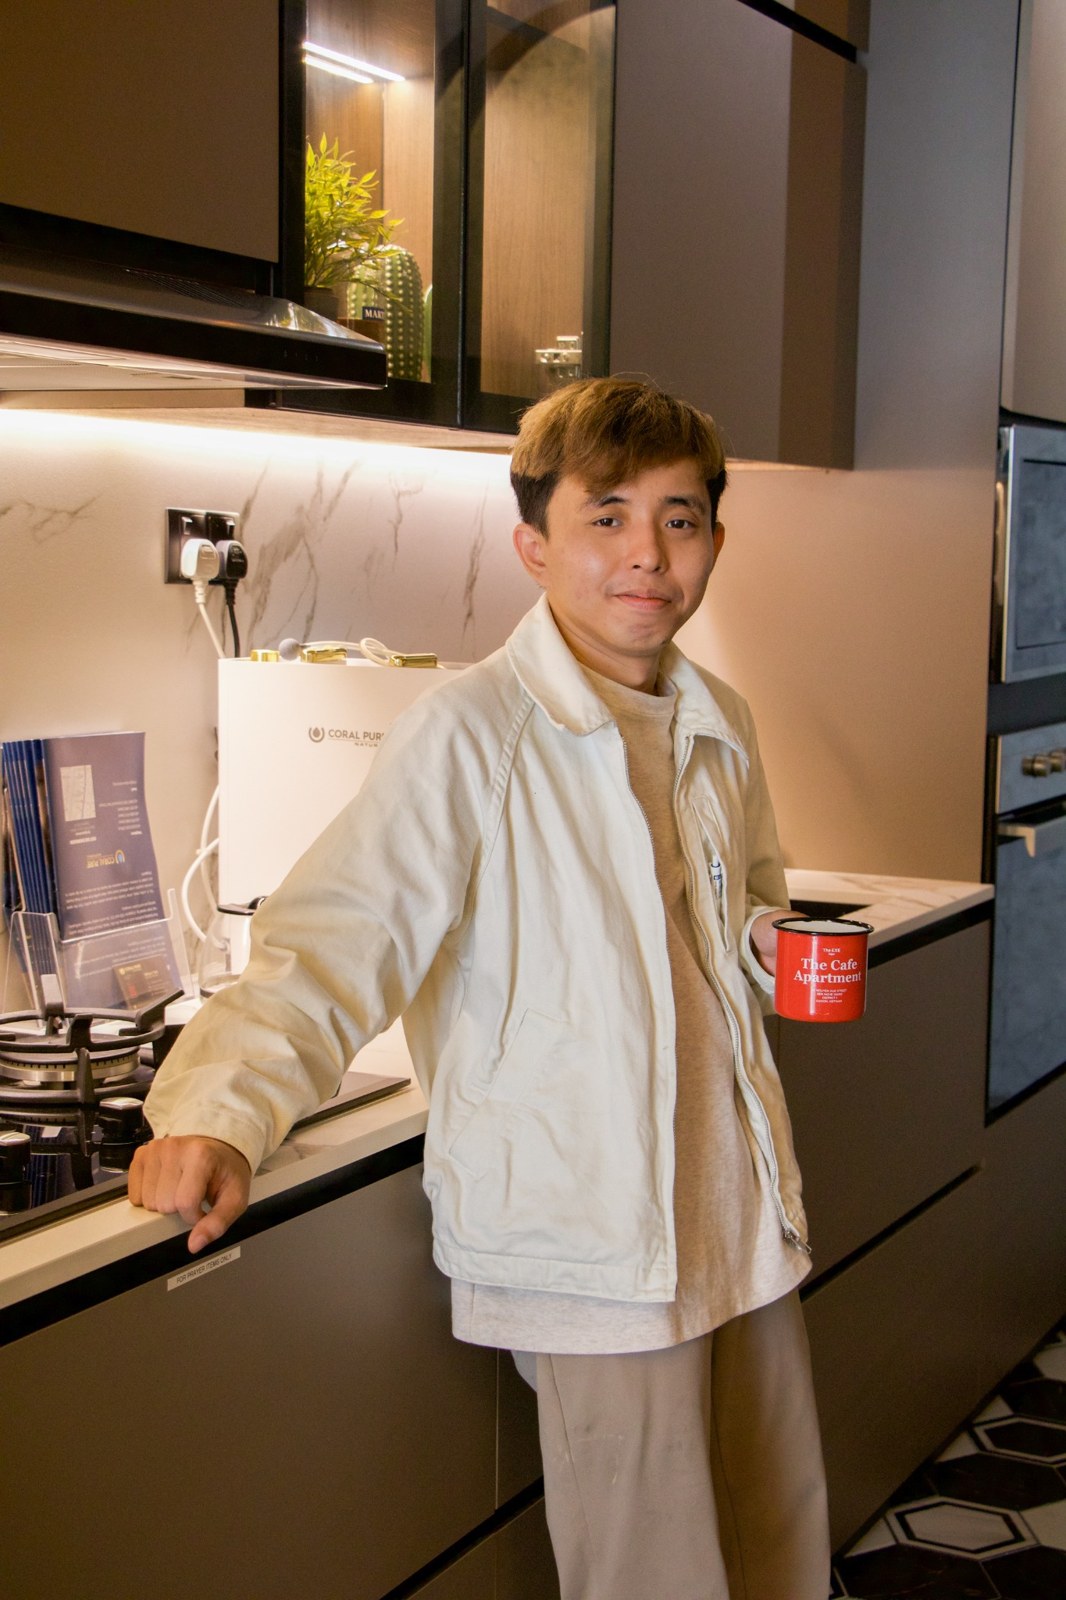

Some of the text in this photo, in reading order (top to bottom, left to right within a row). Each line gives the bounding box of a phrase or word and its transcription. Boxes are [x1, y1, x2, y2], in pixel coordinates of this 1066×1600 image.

[328, 729, 384, 741] CORAL PUR
[801, 958, 858, 970] The Cafe
[794, 970, 861, 984] Apartment
[176, 1253, 232, 1284] FOR PRAYER ITEMS ONLY
